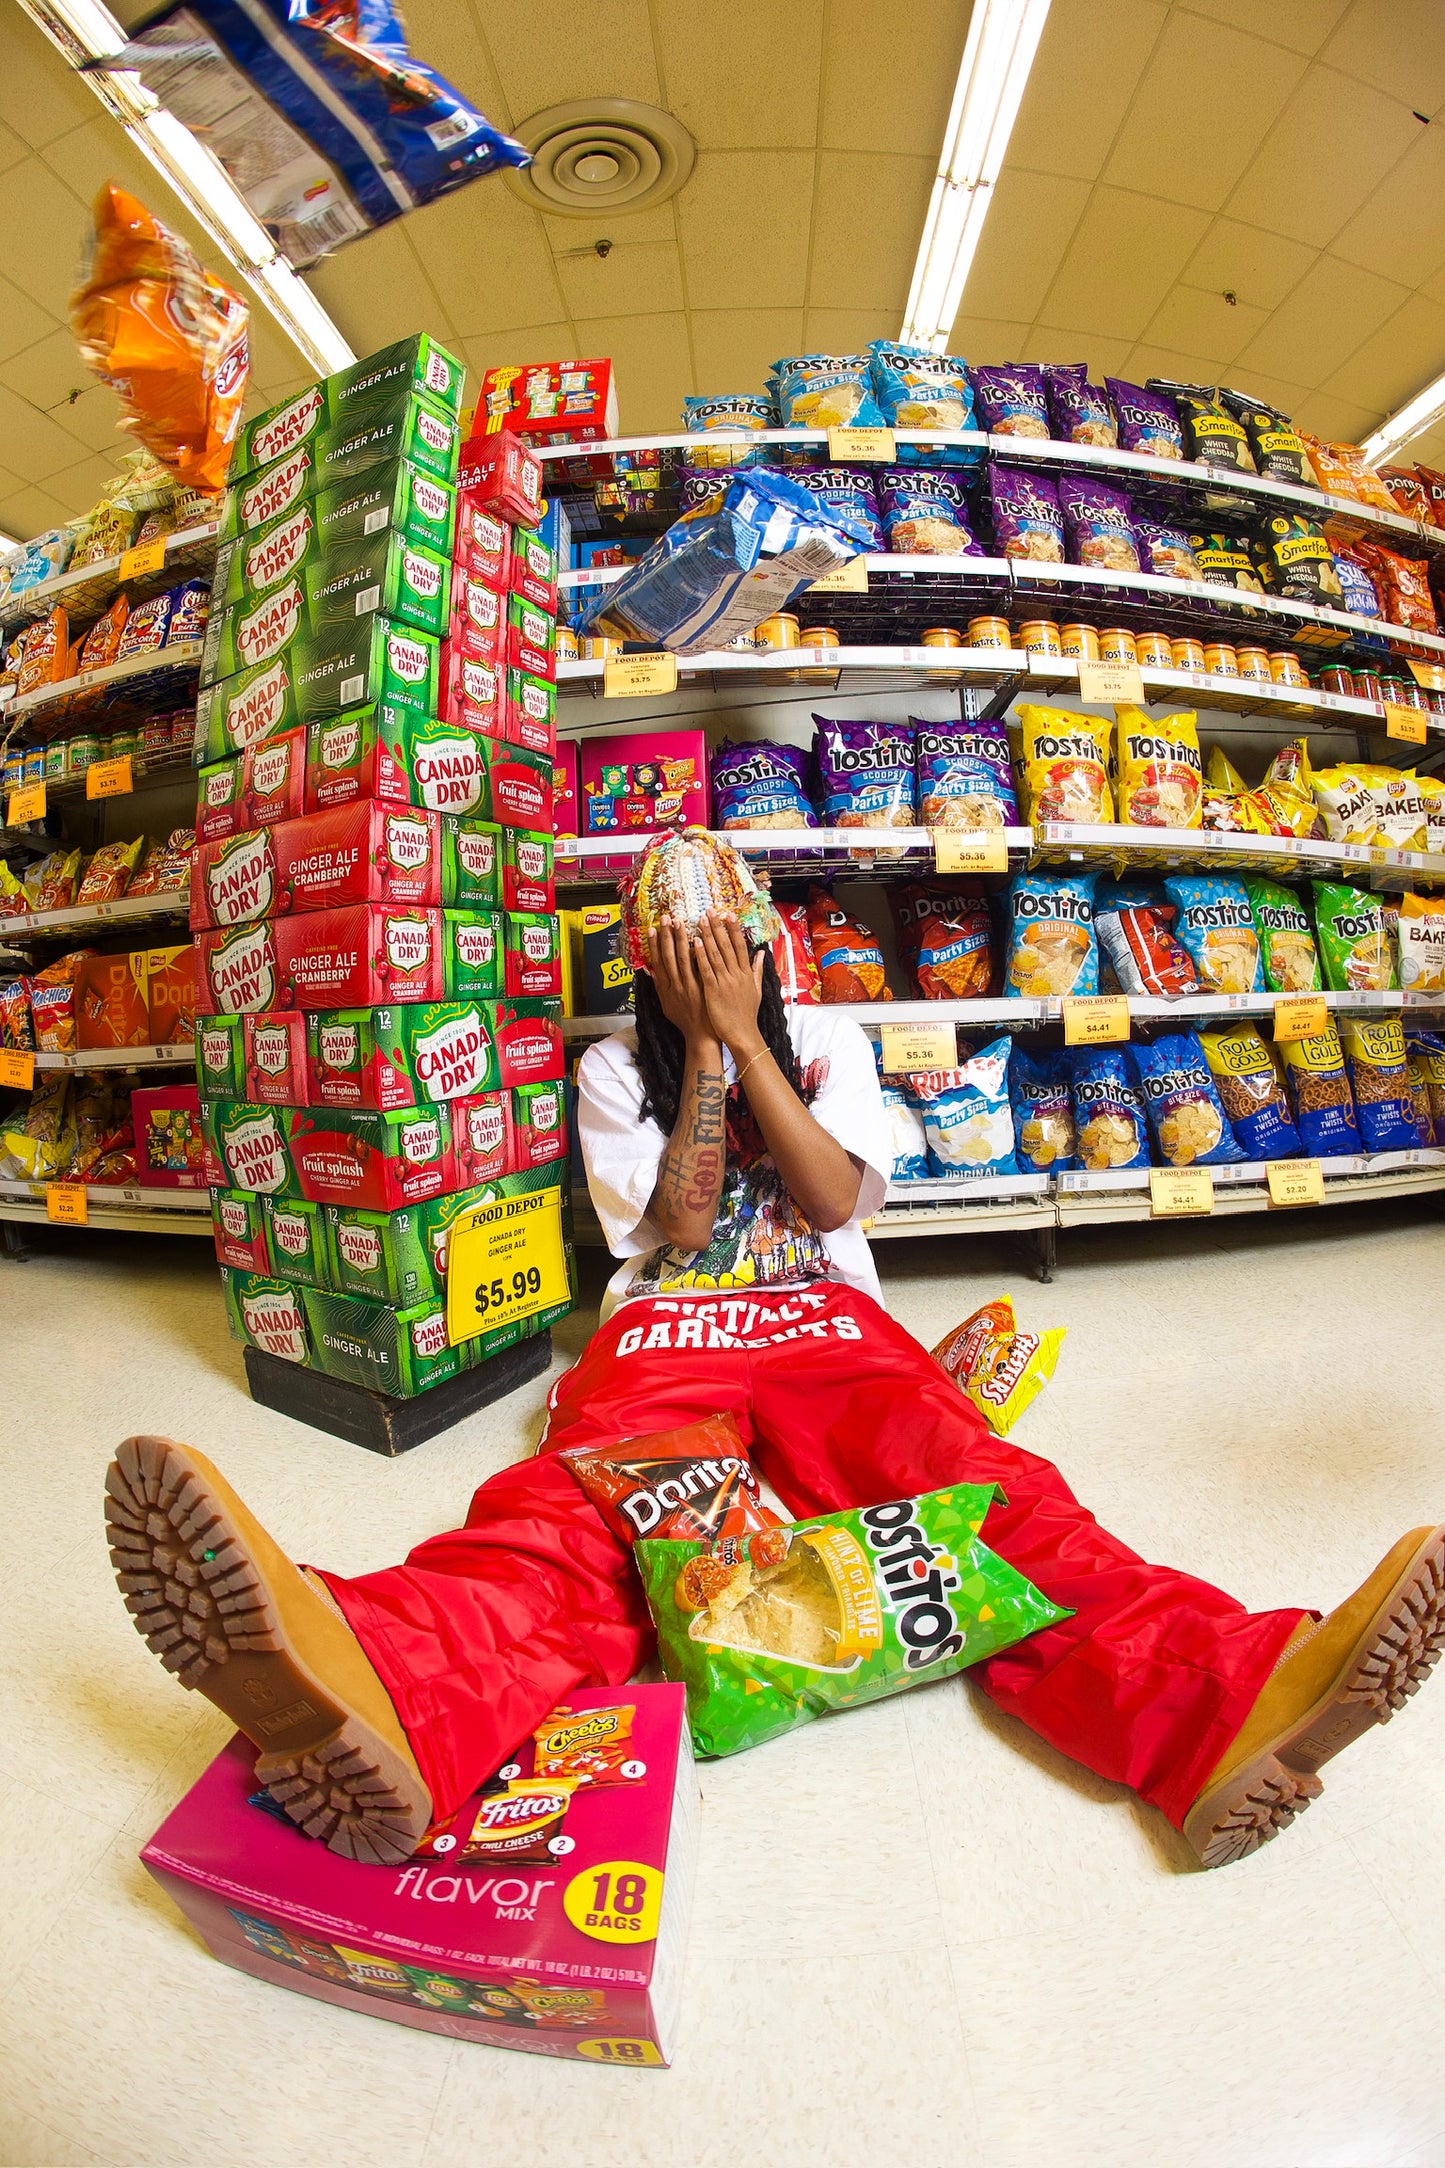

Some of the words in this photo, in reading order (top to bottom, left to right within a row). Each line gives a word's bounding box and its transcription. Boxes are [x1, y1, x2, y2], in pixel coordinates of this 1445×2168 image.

[881, 353, 964, 374] TOSTITO
[338, 375, 381, 400] GINGER
[385, 362, 407, 379] ALE
[694, 399, 782, 421] TOSTITOS
[713, 414, 755, 424] ORIGINAL
[252, 393, 324, 456] CANADA
[270, 421, 306, 458] DRY
[325, 437, 368, 463] GINGER
[371, 424, 394, 441] ALE
[850, 444, 875, 453] $5.36
[1205, 440, 1229, 450] WHITE
[1202, 447, 1235, 459] CHEDDAR
[1271, 454, 1293, 465] WHITE
[1268, 462, 1300, 475] CHEDDAR
[241, 454, 311, 520] CANADA
[881, 472, 963, 506] TOSTITOS
[258, 482, 293, 522] DRY
[901, 507, 931, 519] Party
[1286, 573, 1318, 584] CHEDDAR
[1288, 566, 1312, 575] WHITE
[312, 577, 350, 601] GINGER
[352, 568, 372, 583] ALE
[129, 596, 171, 622] CHESTER'S
[238, 588, 304, 652] CANADA
[254, 619, 290, 658] DRY
[387, 641, 429, 668] CANADA
[297, 664, 334, 686] GINGER
[336, 653, 356, 670] ALE
[399, 658, 419, 675] DRY
[631, 676, 651, 684] $3.75
[226, 671, 290, 733] CANADA
[387, 691, 412, 705] GINGER
[412, 698, 424, 710] ALE
[244, 703, 276, 740] DRY
[320, 732, 360, 753] CANADA
[918, 735, 1009, 764] TOSTITOS
[329, 747, 349, 762] DRY
[414, 753, 487, 784] CANADA
[715, 757, 802, 792] TOSTITOS
[863, 771, 903, 781] SCOOPS!
[100, 779, 117, 788] $3.75
[437, 780, 470, 805] DRY
[498, 782, 517, 798] fruit
[518, 788, 544, 805] splash
[656, 798, 681, 813] Fritos
[737, 801, 768, 816] Party
[771, 796, 798, 810] Size!
[852, 795, 884, 811] Party
[886, 790, 912, 803] Size!
[457, 841, 495, 857] CANADA
[959, 852, 985, 861] $5.36
[289, 851, 334, 874] GINGER
[335, 848, 359, 864] ALE
[468, 856, 487, 869] DRY
[209, 847, 276, 909] CANADA
[294, 865, 352, 886] CRANBERRY
[227, 881, 262, 921] DRY
[915, 897, 990, 919] Doritos
[1038, 924, 1079, 937] ORIGINAL
[1214, 931, 1247, 939] ORIGINAL
[933, 944, 963, 962] Party
[965, 932, 990, 948] Size!
[212, 941, 276, 996] CANADA
[230, 975, 264, 1012] DRY
[110, 965, 127, 1047] Doritos
[1087, 1024, 1109, 1033] $4.41
[1292, 1023, 1311, 1031] $4.41
[1307, 1029, 1337, 1045] ROLD
[1366, 1024, 1401, 1040] ROLD
[416, 1025, 491, 1081] CANADA
[506, 1044, 525, 1058] fruit
[527, 1041, 552, 1054] splash
[906, 1051, 934, 1059] $5.36
[1222, 1039, 1261, 1057] ROLD
[1310, 1040, 1342, 1058] GOLD
[1371, 1039, 1404, 1056] GOLD
[1229, 1053, 1266, 1070] GOLD
[441, 1057, 478, 1095] DRY
[1144, 1070, 1211, 1097] TOSTITOS
[1075, 1080, 1144, 1105] TOSTITOS
[1168, 1095, 1184, 1106] BITE
[1184, 1091, 1200, 1101] SIZE
[693, 1070, 724, 1146] FIRST
[941, 1109, 965, 1127] Party
[966, 1101, 988, 1117] Size!
[1257, 1112, 1272, 1122] TINY
[1324, 1111, 1339, 1120] TINY
[1377, 1112, 1400, 1121] TWISTS
[1381, 1105, 1396, 1113] TINY
[1254, 1118, 1279, 1131] TWISTS
[1321, 1118, 1343, 1129] TWISTS
[1255, 1127, 1283, 1142] ORIGINAL
[226, 1130, 285, 1171] CANADA
[244, 1161, 276, 1187] DRY
[302, 1157, 326, 1174] fruit
[327, 1160, 364, 1177] splash
[685, 1150, 719, 1214] GOD
[1286, 1186, 1307, 1194] $2.20
[471, 1207, 501, 1227] FOOD
[507, 1195, 545, 1214] DEPOT
[489, 1231, 510, 1244] CANADA
[513, 1227, 526, 1237] DRY
[488, 1244, 510, 1257] GINGER
[511, 1240, 526, 1250] ALE
[475, 1266, 541, 1316] $5.99
[244, 1309, 305, 1335] CANADA
[483, 1315, 496, 1325] Plus
[497, 1311, 508, 1321] 10%
[517, 1300, 540, 1314] Register
[266, 1334, 296, 1354] DRY
[616, 1316, 862, 1358] GARMENTS
[323, 1334, 363, 1358] GINGER
[367, 1348, 389, 1364] ALE
[980, 1333, 1040, 1406] CHESTER'S
[622, 1458, 756, 1536] Doritos
[829, 1533, 859, 1568] HINT
[850, 1568, 864, 1584] OF
[864, 1501, 964, 1669] OSTITOS
[824, 1546, 844, 1584] FLAVORED
[842, 1584, 855, 1630] TRIANGLES
[853, 1589, 878, 1639] LIME
[545, 1716, 618, 1754] Cheetos
[504, 1766, 513, 1778] 3
[628, 1763, 638, 1776] 4
[481, 1794, 563, 1829] Fritos
[440, 1838, 450, 1850] 3
[480, 1839, 503, 1851] CHILI
[505, 1832, 544, 1849] CHEESE
[557, 1839, 566, 1851] 2
[394, 1867, 555, 1906] flavor
[593, 1872, 646, 1916] 18
[495, 1906, 538, 1922] MIX
[584, 1914, 642, 1931] BAGS
[349, 1963, 405, 1982] Fritos
[594, 2041, 644, 2058] 18
